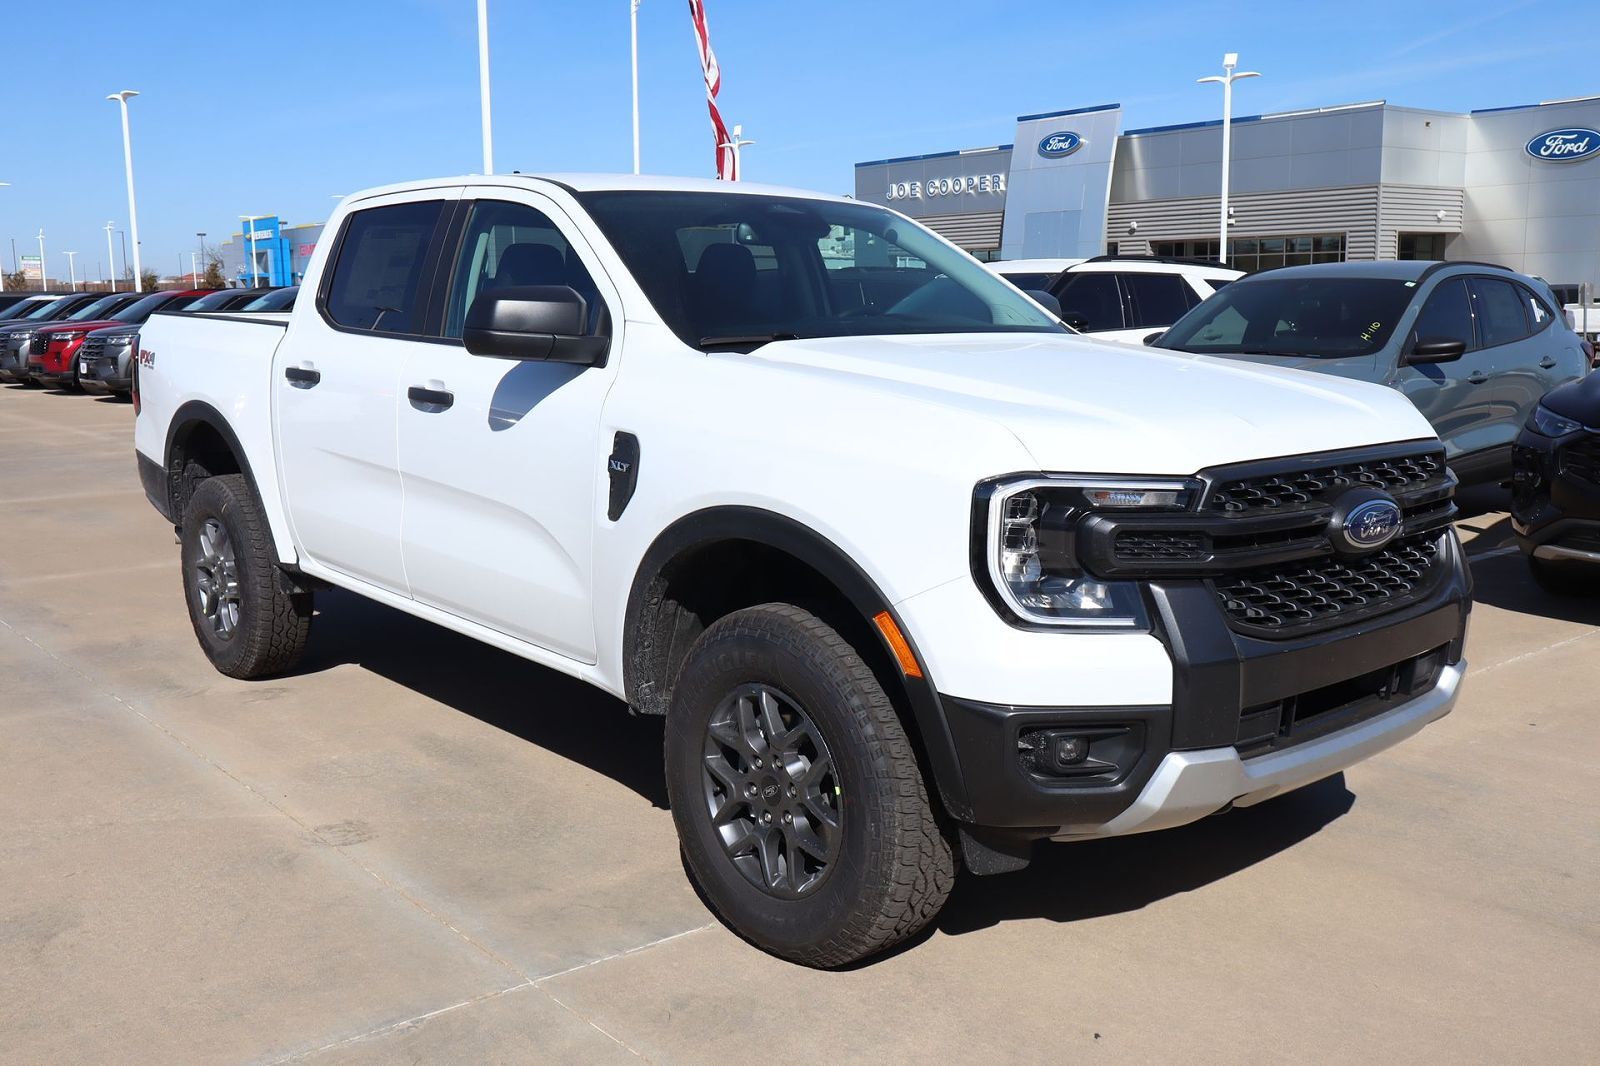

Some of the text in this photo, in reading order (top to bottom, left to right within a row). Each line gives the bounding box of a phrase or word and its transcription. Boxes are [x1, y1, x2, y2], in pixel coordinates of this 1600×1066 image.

[1046, 136, 1071, 151] Ford
[1540, 133, 1590, 156] Ford
[886, 174, 1005, 200] JOE COOPER
[610, 460, 630, 473] XLT
[1360, 509, 1391, 538] Ford
